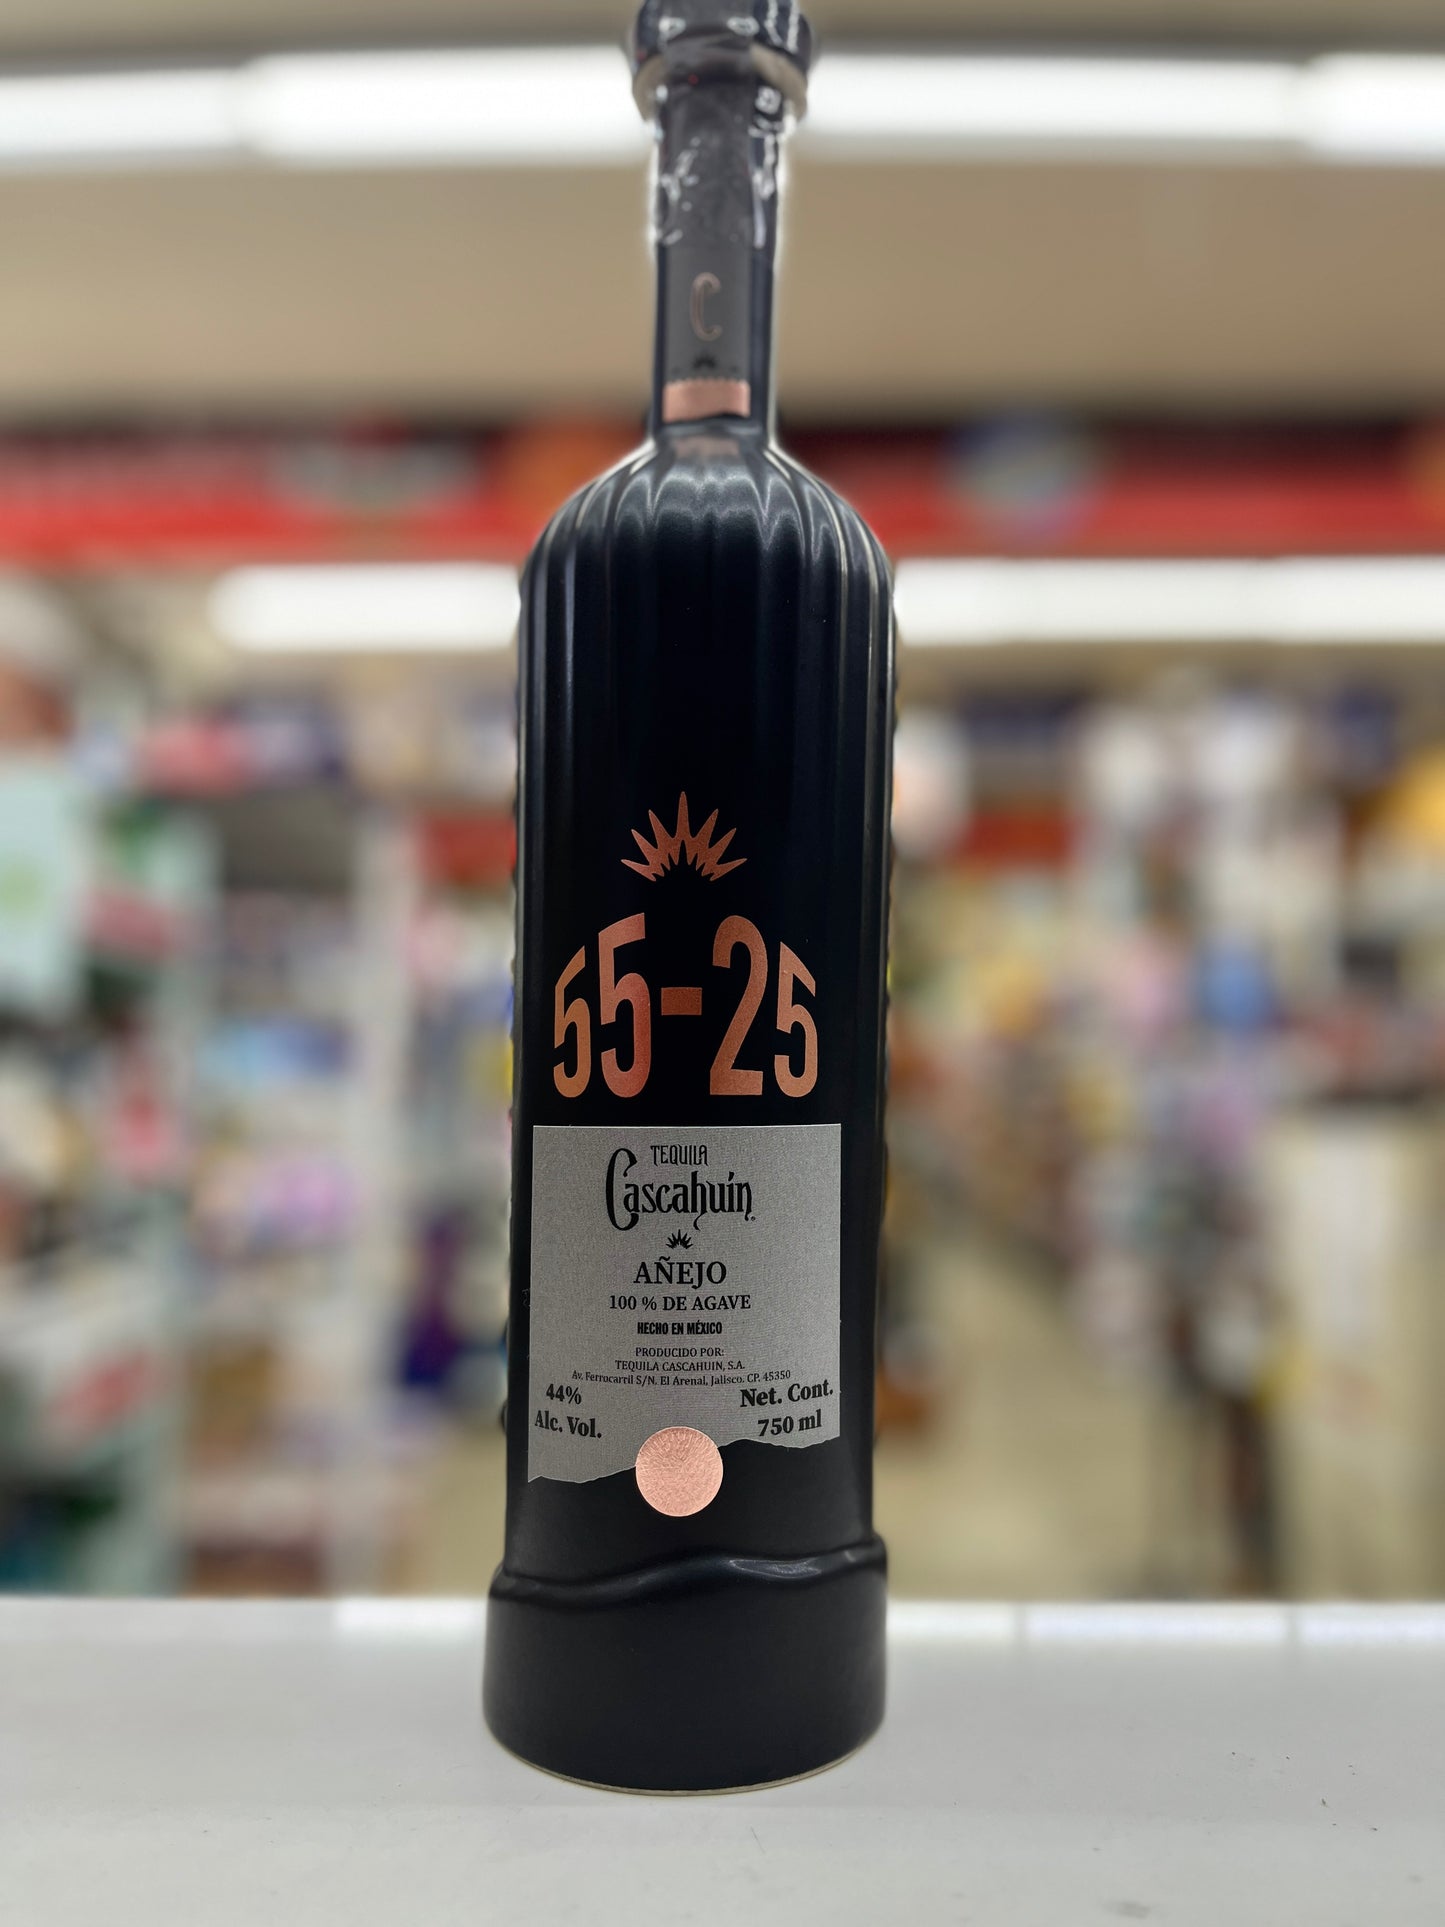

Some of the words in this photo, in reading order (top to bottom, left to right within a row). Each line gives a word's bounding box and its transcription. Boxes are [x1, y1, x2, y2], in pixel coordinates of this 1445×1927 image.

[553, 912, 818, 1098] 55-25
[650, 1144, 708, 1166] TEQUILA
[633, 1256, 727, 1289] AÑEJO
[609, 1295, 637, 1310] 100
[642, 1296, 657, 1311] %
[662, 1296, 687, 1311] DE
[691, 1295, 751, 1311] AGAVE
[637, 1322, 669, 1335] HECHO
[671, 1322, 684, 1335] EN
[687, 1320, 723, 1335] MÉXICO
[635, 1347, 698, 1358] PRODUCIDO
[700, 1347, 725, 1357] POR:
[571, 1370, 584, 1381] Av.
[585, 1371, 634, 1385] Ferrocarril
[660, 1376, 670, 1386] El
[762, 1369, 791, 1382] 45350
[615, 1360, 660, 1373] TEQUILA
[662, 1361, 726, 1372] CASCAHUIN,
[727, 1360, 746, 1371] S.A.
[546, 1383, 582, 1405] 44%
[740, 1387, 783, 1408] Net.
[787, 1379, 834, 1402] Cont.
[534, 1410, 563, 1433] Alc.
[566, 1415, 602, 1439] Vol.
[757, 1415, 795, 1437] 750
[798, 1408, 822, 1432] ml
